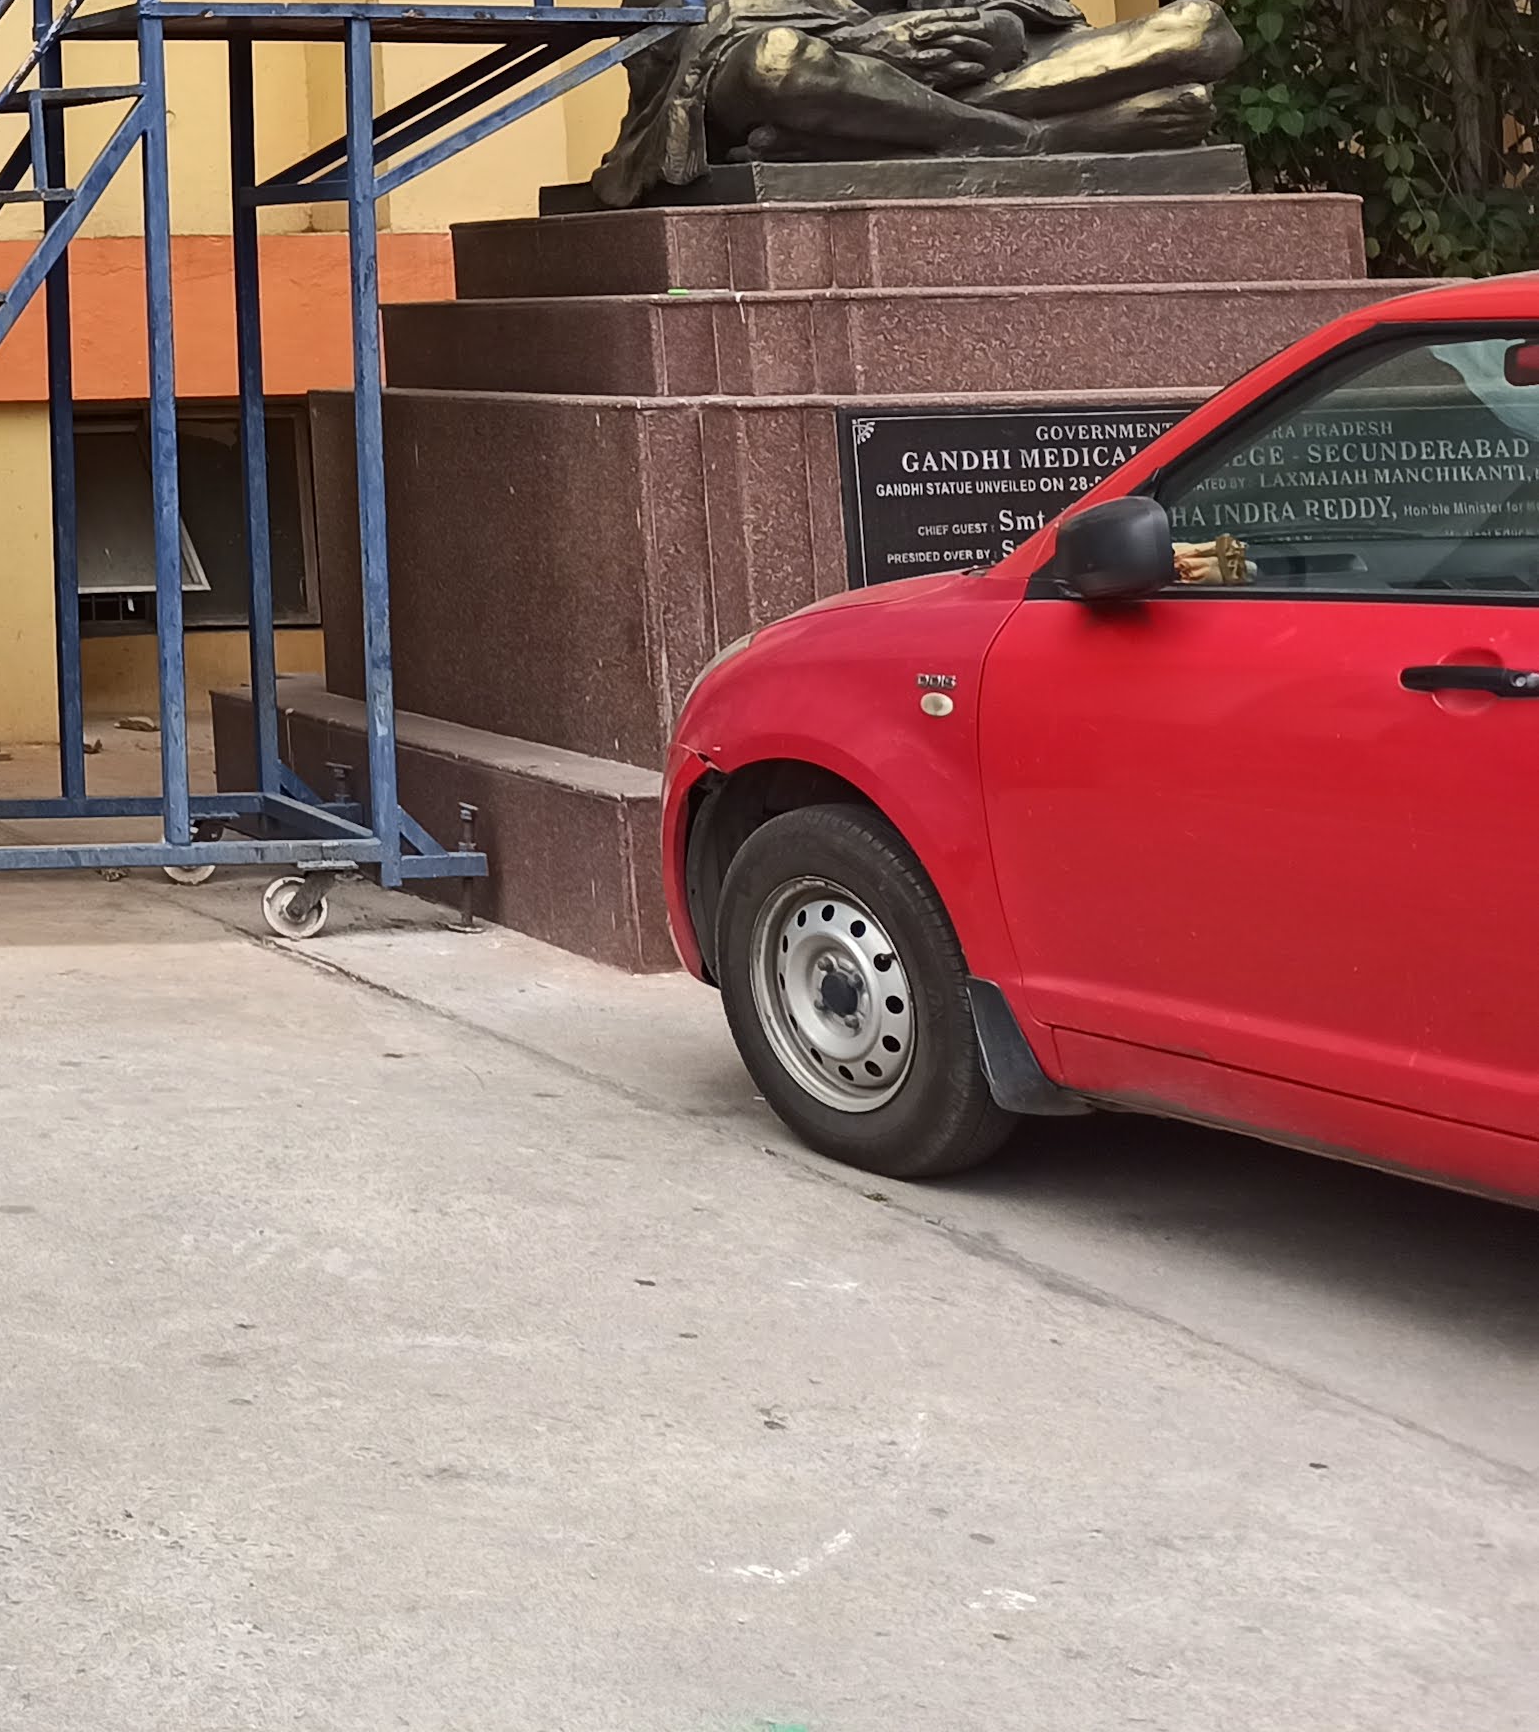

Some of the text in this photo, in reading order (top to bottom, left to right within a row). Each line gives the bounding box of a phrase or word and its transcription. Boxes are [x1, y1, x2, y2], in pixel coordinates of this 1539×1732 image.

[1303, 421, 1393, 437] PRADESH
[901, 448, 1012, 474] GANDHI
[1307, 438, 1530, 464] SECUNDERABAD
[876, 483, 924, 498] GANDHI
[926, 480, 973, 496] STATUE
[975, 479, 1037, 494] UNVEILED
[1040, 476, 1064, 493] ON
[1229, 476, 1246, 489] BY
[1260, 468, 1367, 489] LAXMAIAH
[1374, 464, 1532, 485] MANCHIKANTI,
[1213, 500, 1296, 527] INDRA
[1303, 495, 1398, 522] REDDY,
[1403, 502, 1450, 517] Hon'ble
[1453, 501, 1502, 516] Minister
[1506, 500, 1523, 514] for
[917, 524, 949, 537] CHIEF
[952, 522, 988, 535] GUEST
[886, 550, 940, 564] PRESIDED
[943, 549, 974, 562] OVER
[976, 548, 991, 560] BY
